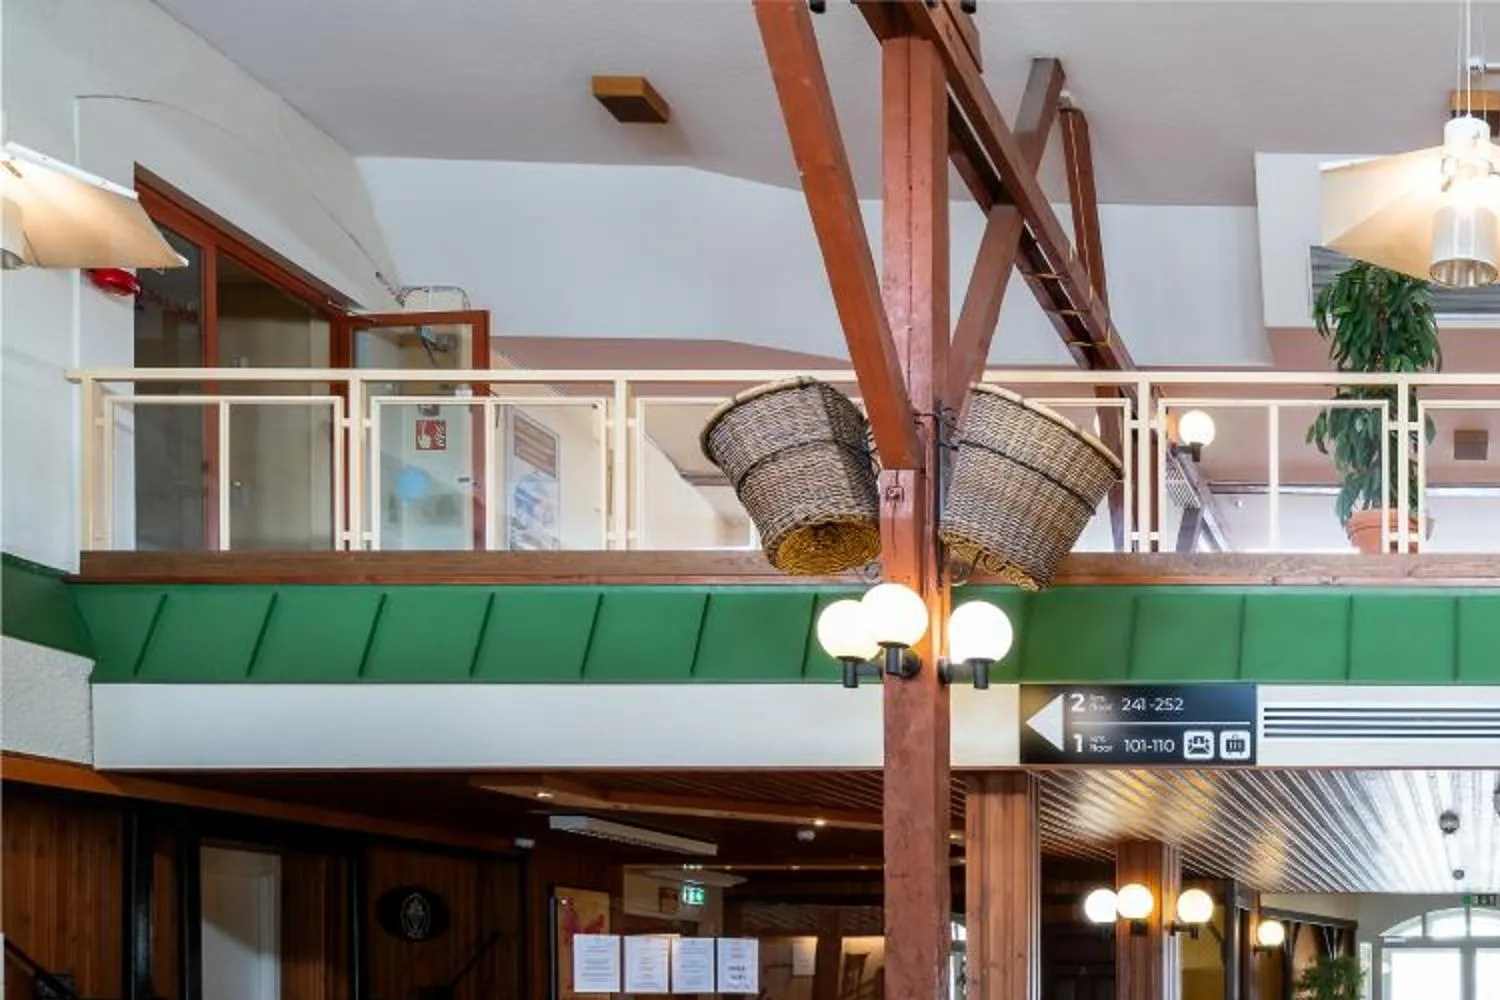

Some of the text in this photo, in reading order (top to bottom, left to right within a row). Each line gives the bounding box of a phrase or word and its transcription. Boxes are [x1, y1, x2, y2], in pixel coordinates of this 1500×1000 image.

[1071, 693, 1085, 712] 2
[1073, 733, 1175, 753] 1 101-110
